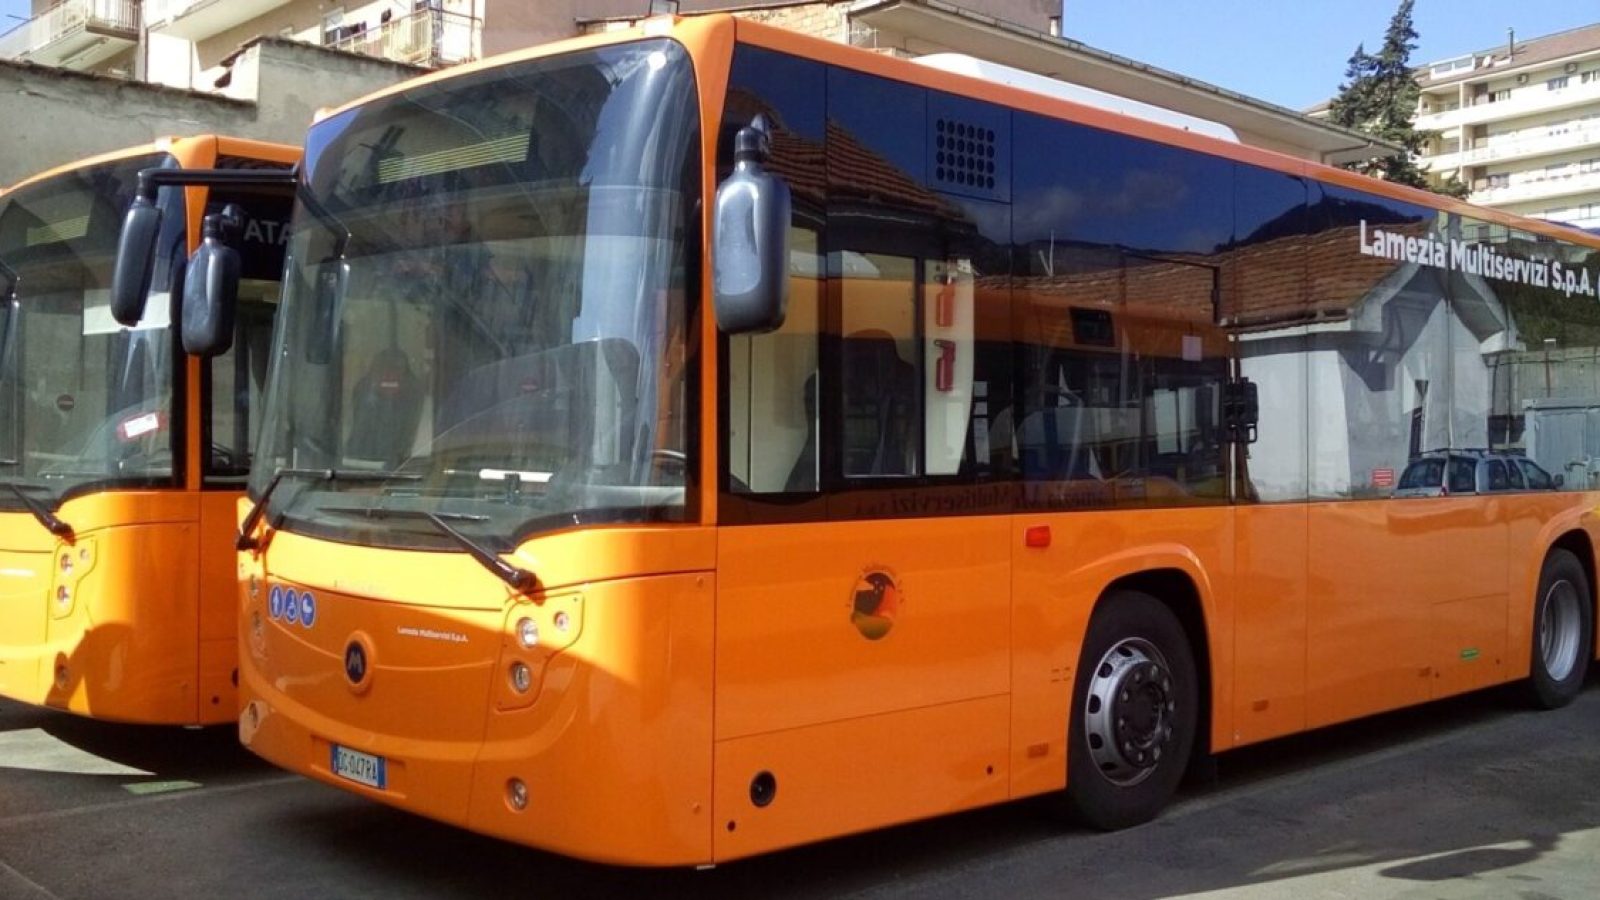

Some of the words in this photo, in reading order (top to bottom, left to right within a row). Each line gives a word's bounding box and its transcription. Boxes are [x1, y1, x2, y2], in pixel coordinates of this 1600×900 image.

[1359, 219, 1446, 268] Lamezia
[1451, 238, 1549, 288] Multiservizi
[1552, 260, 1595, 298] S.p.A.
